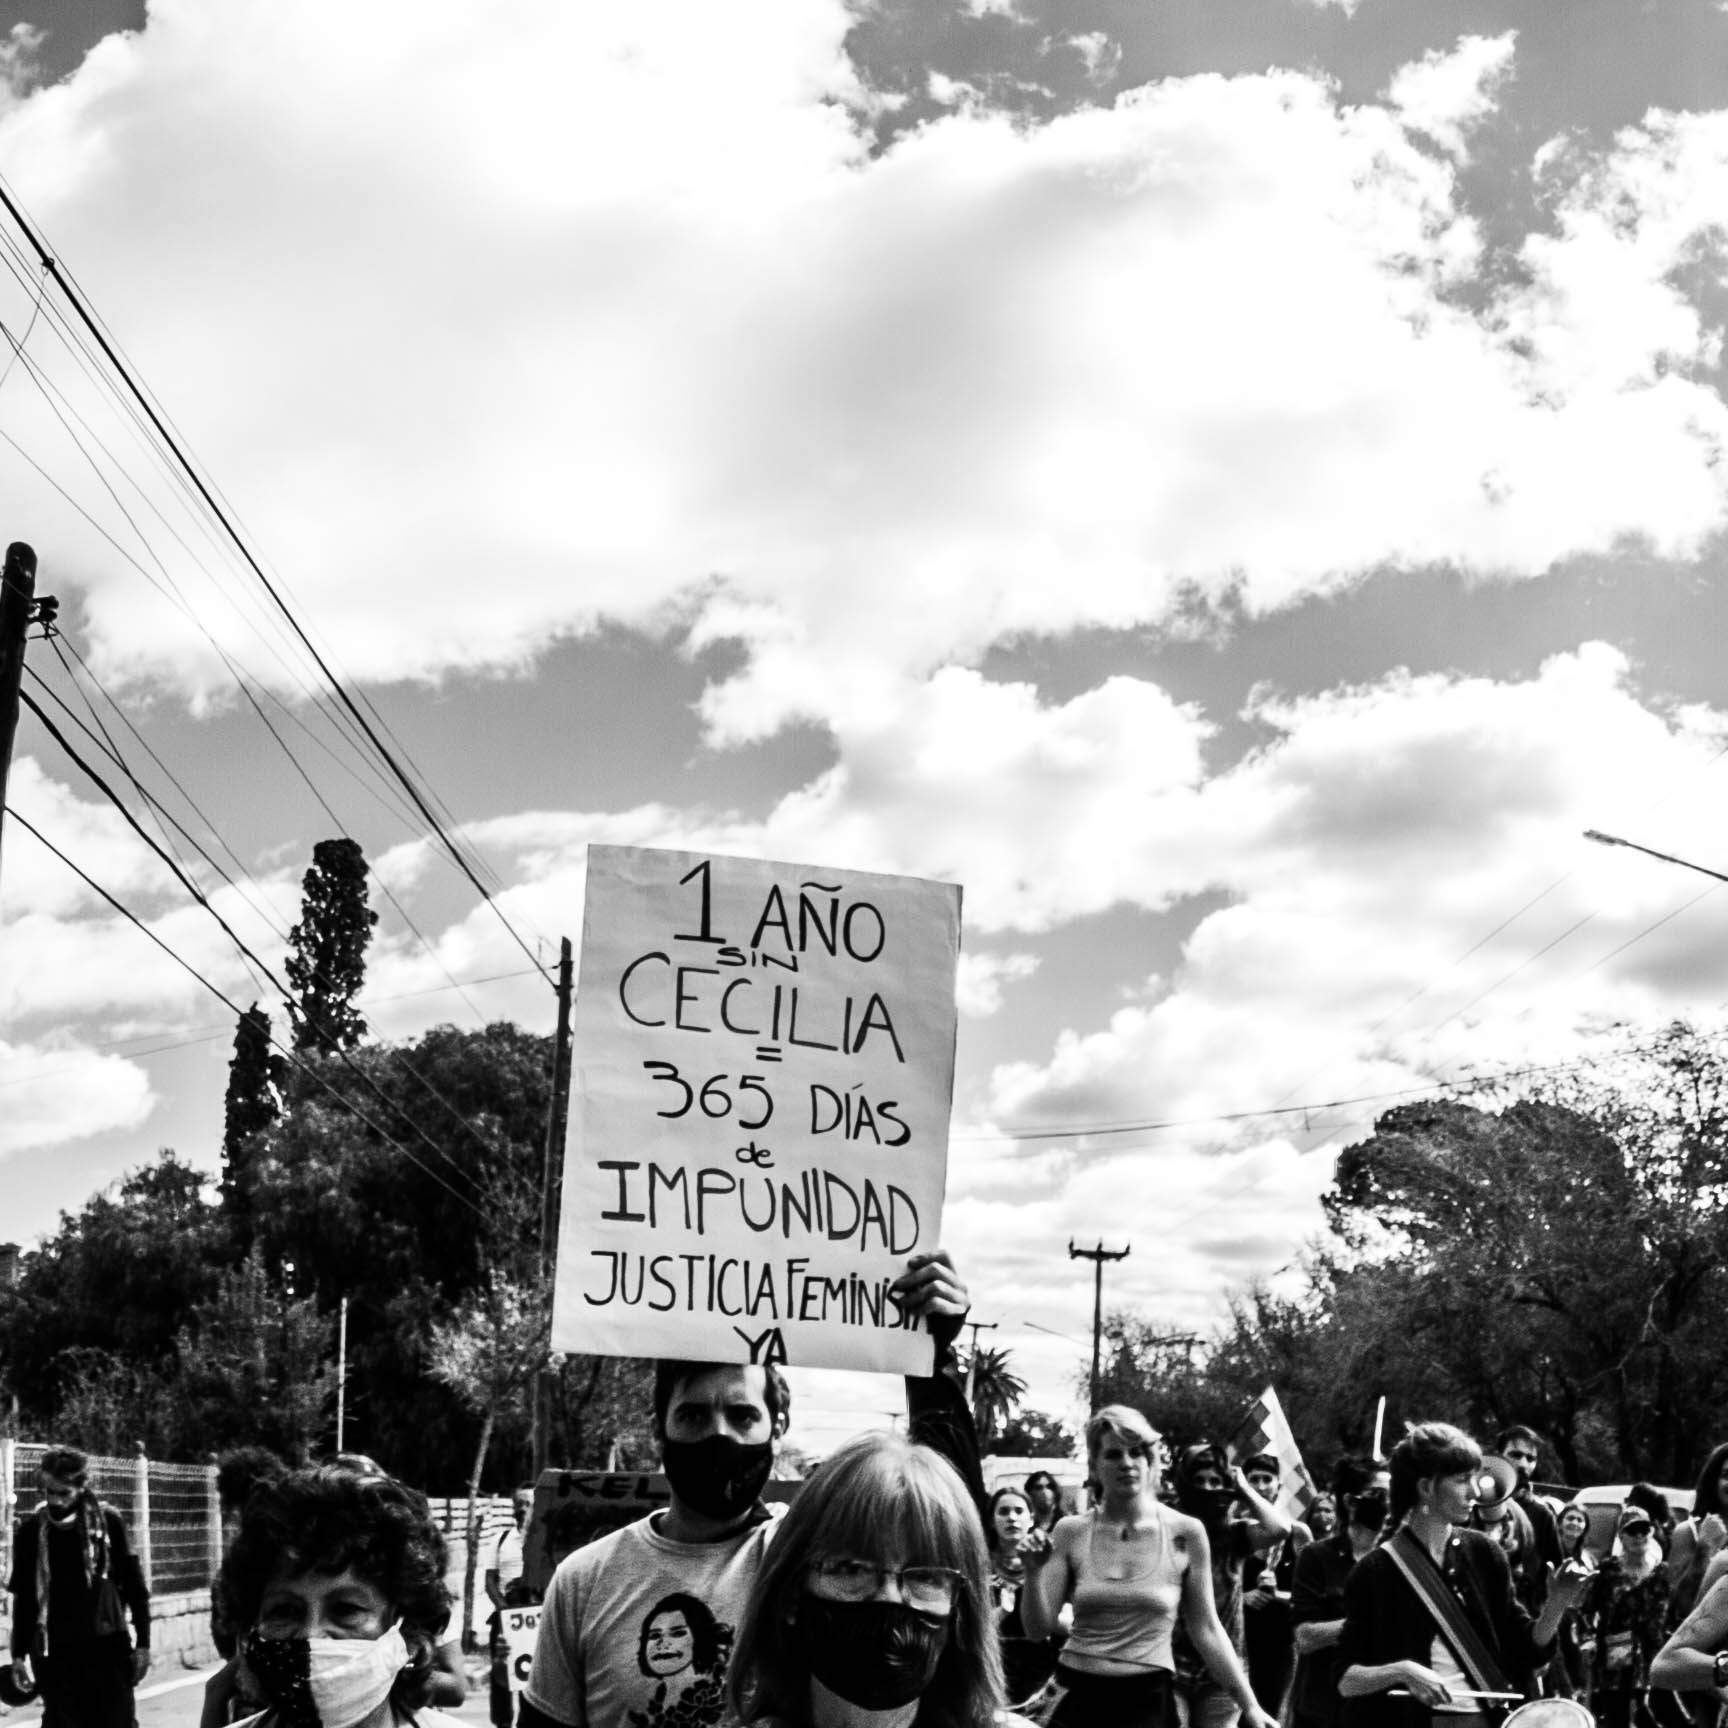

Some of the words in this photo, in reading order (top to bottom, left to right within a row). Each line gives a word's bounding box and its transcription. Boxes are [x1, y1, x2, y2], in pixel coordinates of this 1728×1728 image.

[673, 860, 727, 945] 1
[750, 881, 886, 963] AÑO
[619, 951, 905, 1064] CECILIA
[642, 1060, 774, 1130] 365
[810, 1082, 912, 1147] DÍAS
[735, 1141, 775, 1169] de
[597, 1160, 920, 1256] IMPUNIDAD
[583, 1250, 779, 1321] JUSTICIA
[733, 1326, 788, 1366] YA
